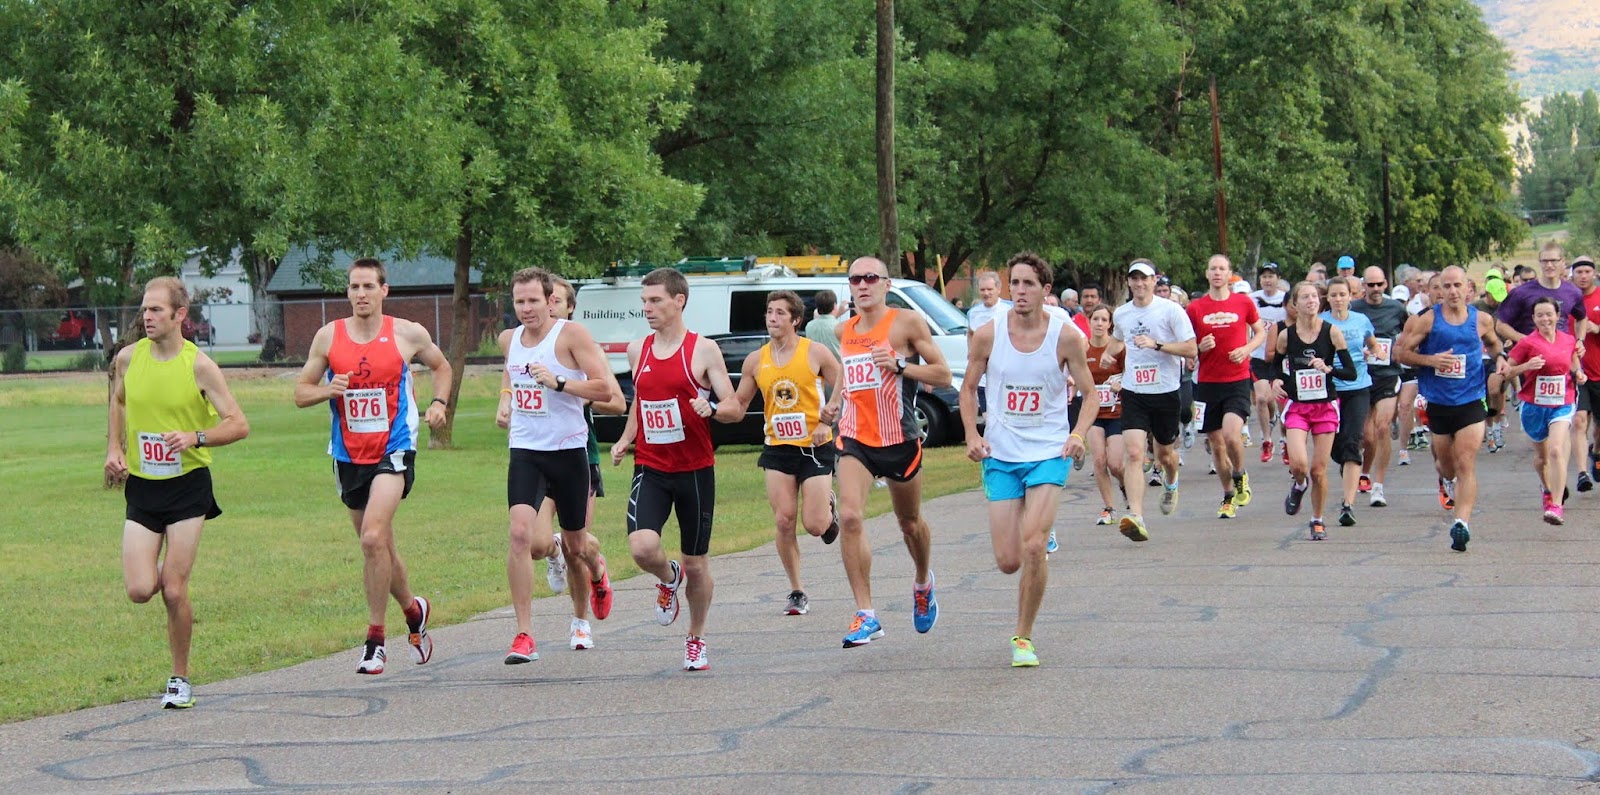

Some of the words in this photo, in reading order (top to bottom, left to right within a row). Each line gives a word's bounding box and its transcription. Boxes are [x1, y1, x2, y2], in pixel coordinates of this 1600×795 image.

[583, 310, 625, 321] Building
[847, 362, 875, 385] 882
[1135, 369, 1156, 383] 897
[1300, 375, 1322, 389] 916
[1540, 382, 1561, 395] 901
[349, 398, 381, 418] 876
[516, 389, 542, 410] 925
[1007, 391, 1040, 412] 873
[646, 409, 675, 429] 861
[776, 421, 803, 437] 909
[143, 442, 176, 461] 902
